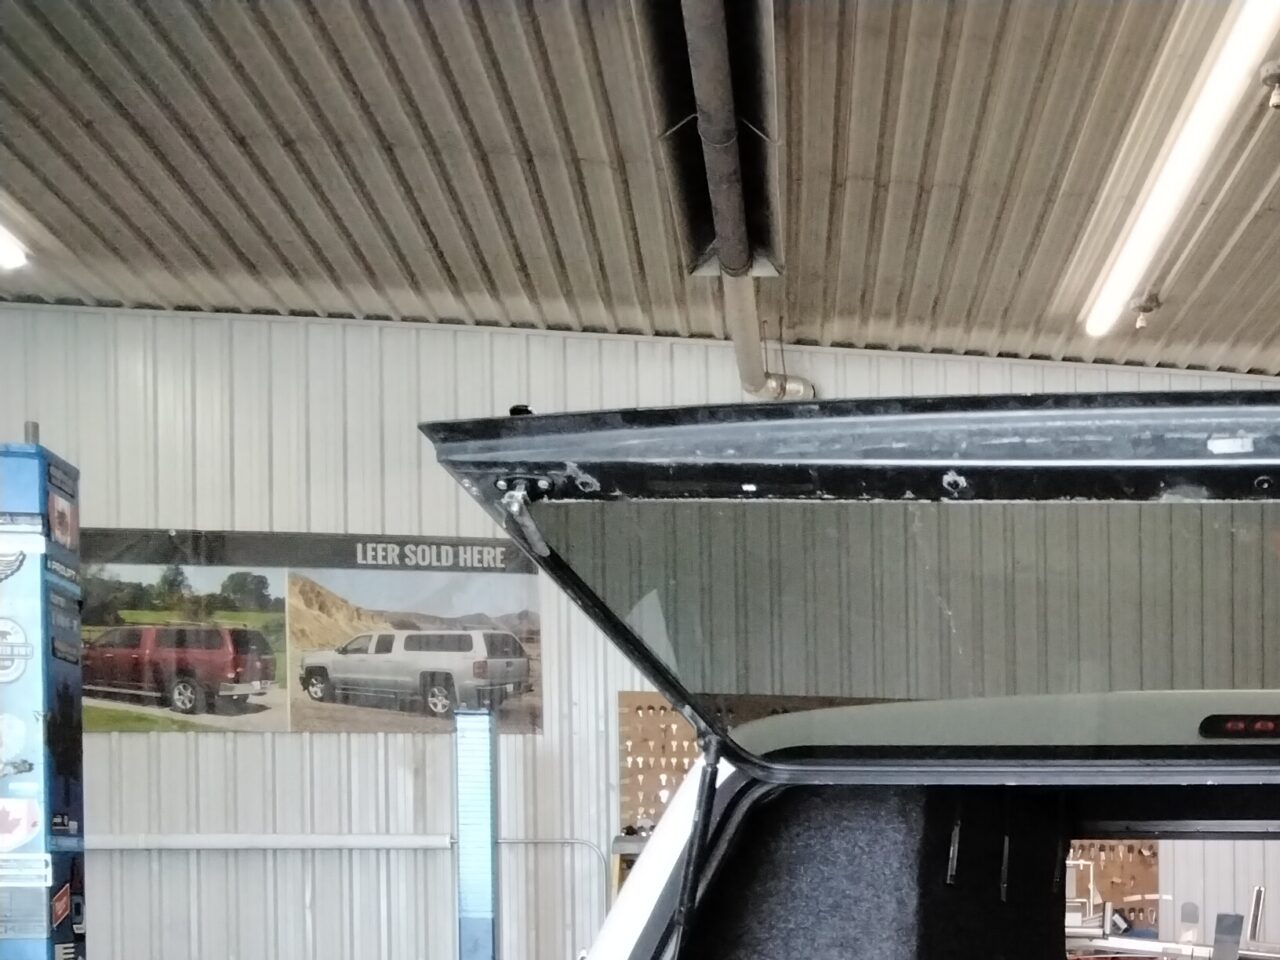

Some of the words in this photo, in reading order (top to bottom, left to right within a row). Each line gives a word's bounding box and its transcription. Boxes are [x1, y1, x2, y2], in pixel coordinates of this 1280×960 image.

[356, 543, 399, 565] LEER
[404, 544, 453, 566] SOLD
[459, 546, 505, 568] HERE
